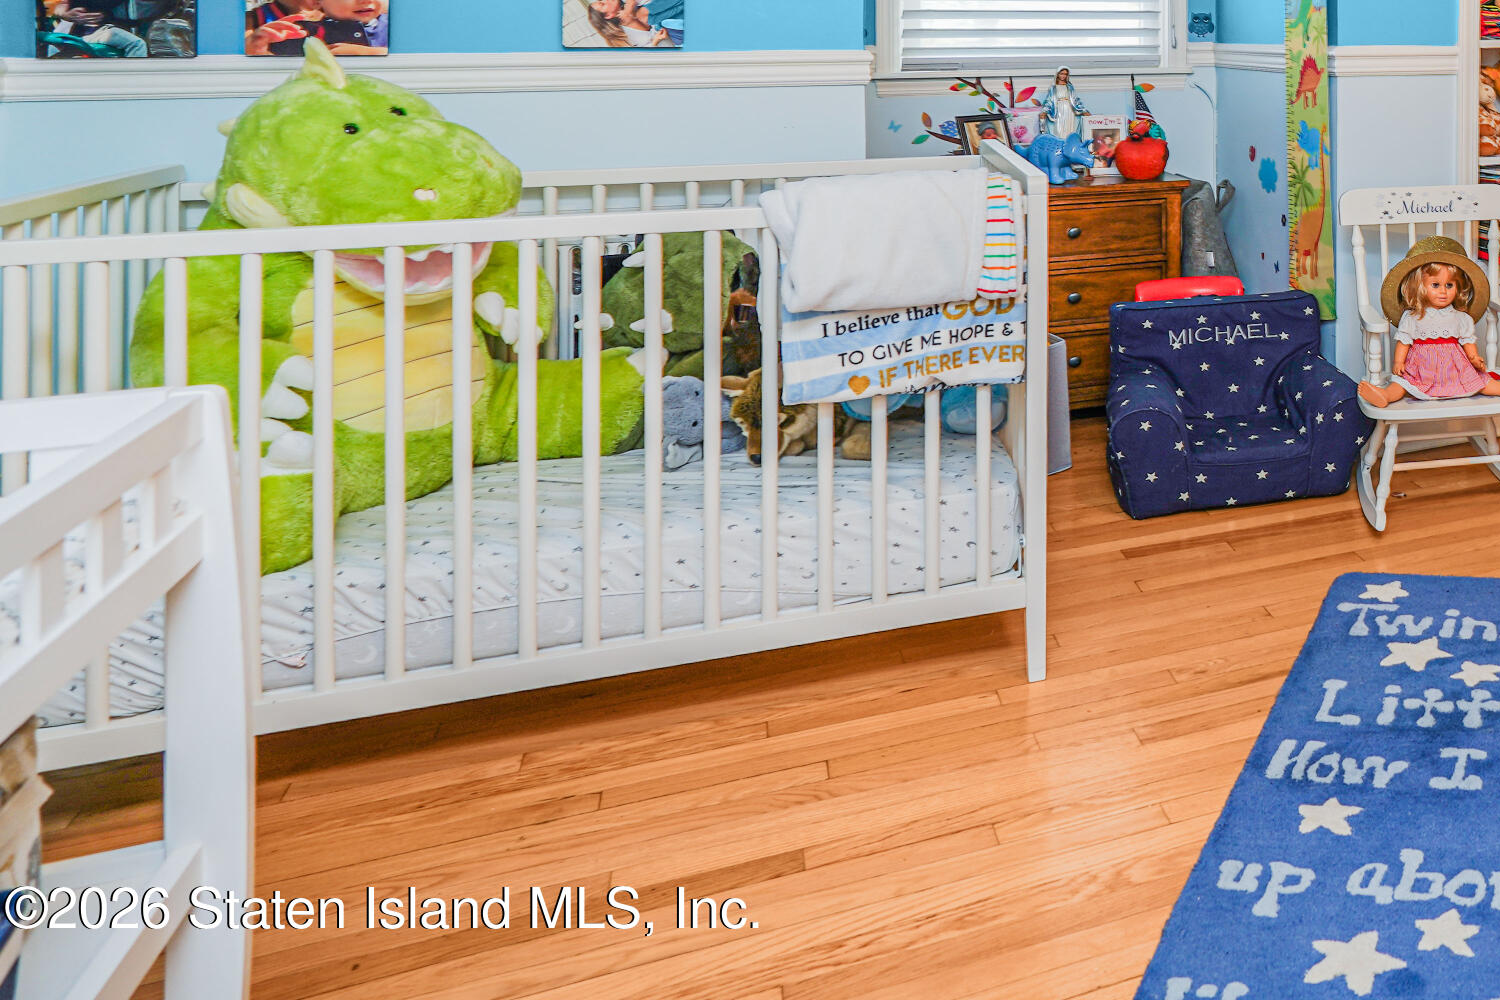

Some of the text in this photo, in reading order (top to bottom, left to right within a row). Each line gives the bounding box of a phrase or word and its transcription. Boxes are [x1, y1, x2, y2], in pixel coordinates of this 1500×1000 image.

[1396, 200, 1455, 216] Michael
[821, 295, 1015, 339] I believe that GOD
[1168, 323, 1281, 345] MICHAEL
[838, 350, 864, 368] TO
[872, 338, 913, 360] GIVE
[920, 330, 942, 350] ME
[949, 323, 995, 345] HOPE
[1002, 322, 1014, 336] &
[878, 366, 898, 389] IF
[904, 350, 963, 380] THERE
[969, 344, 1025, 365] EVER
[1265, 739, 1409, 788] How
[1429, 747, 1488, 791] I
[1216, 859, 1316, 918] up
